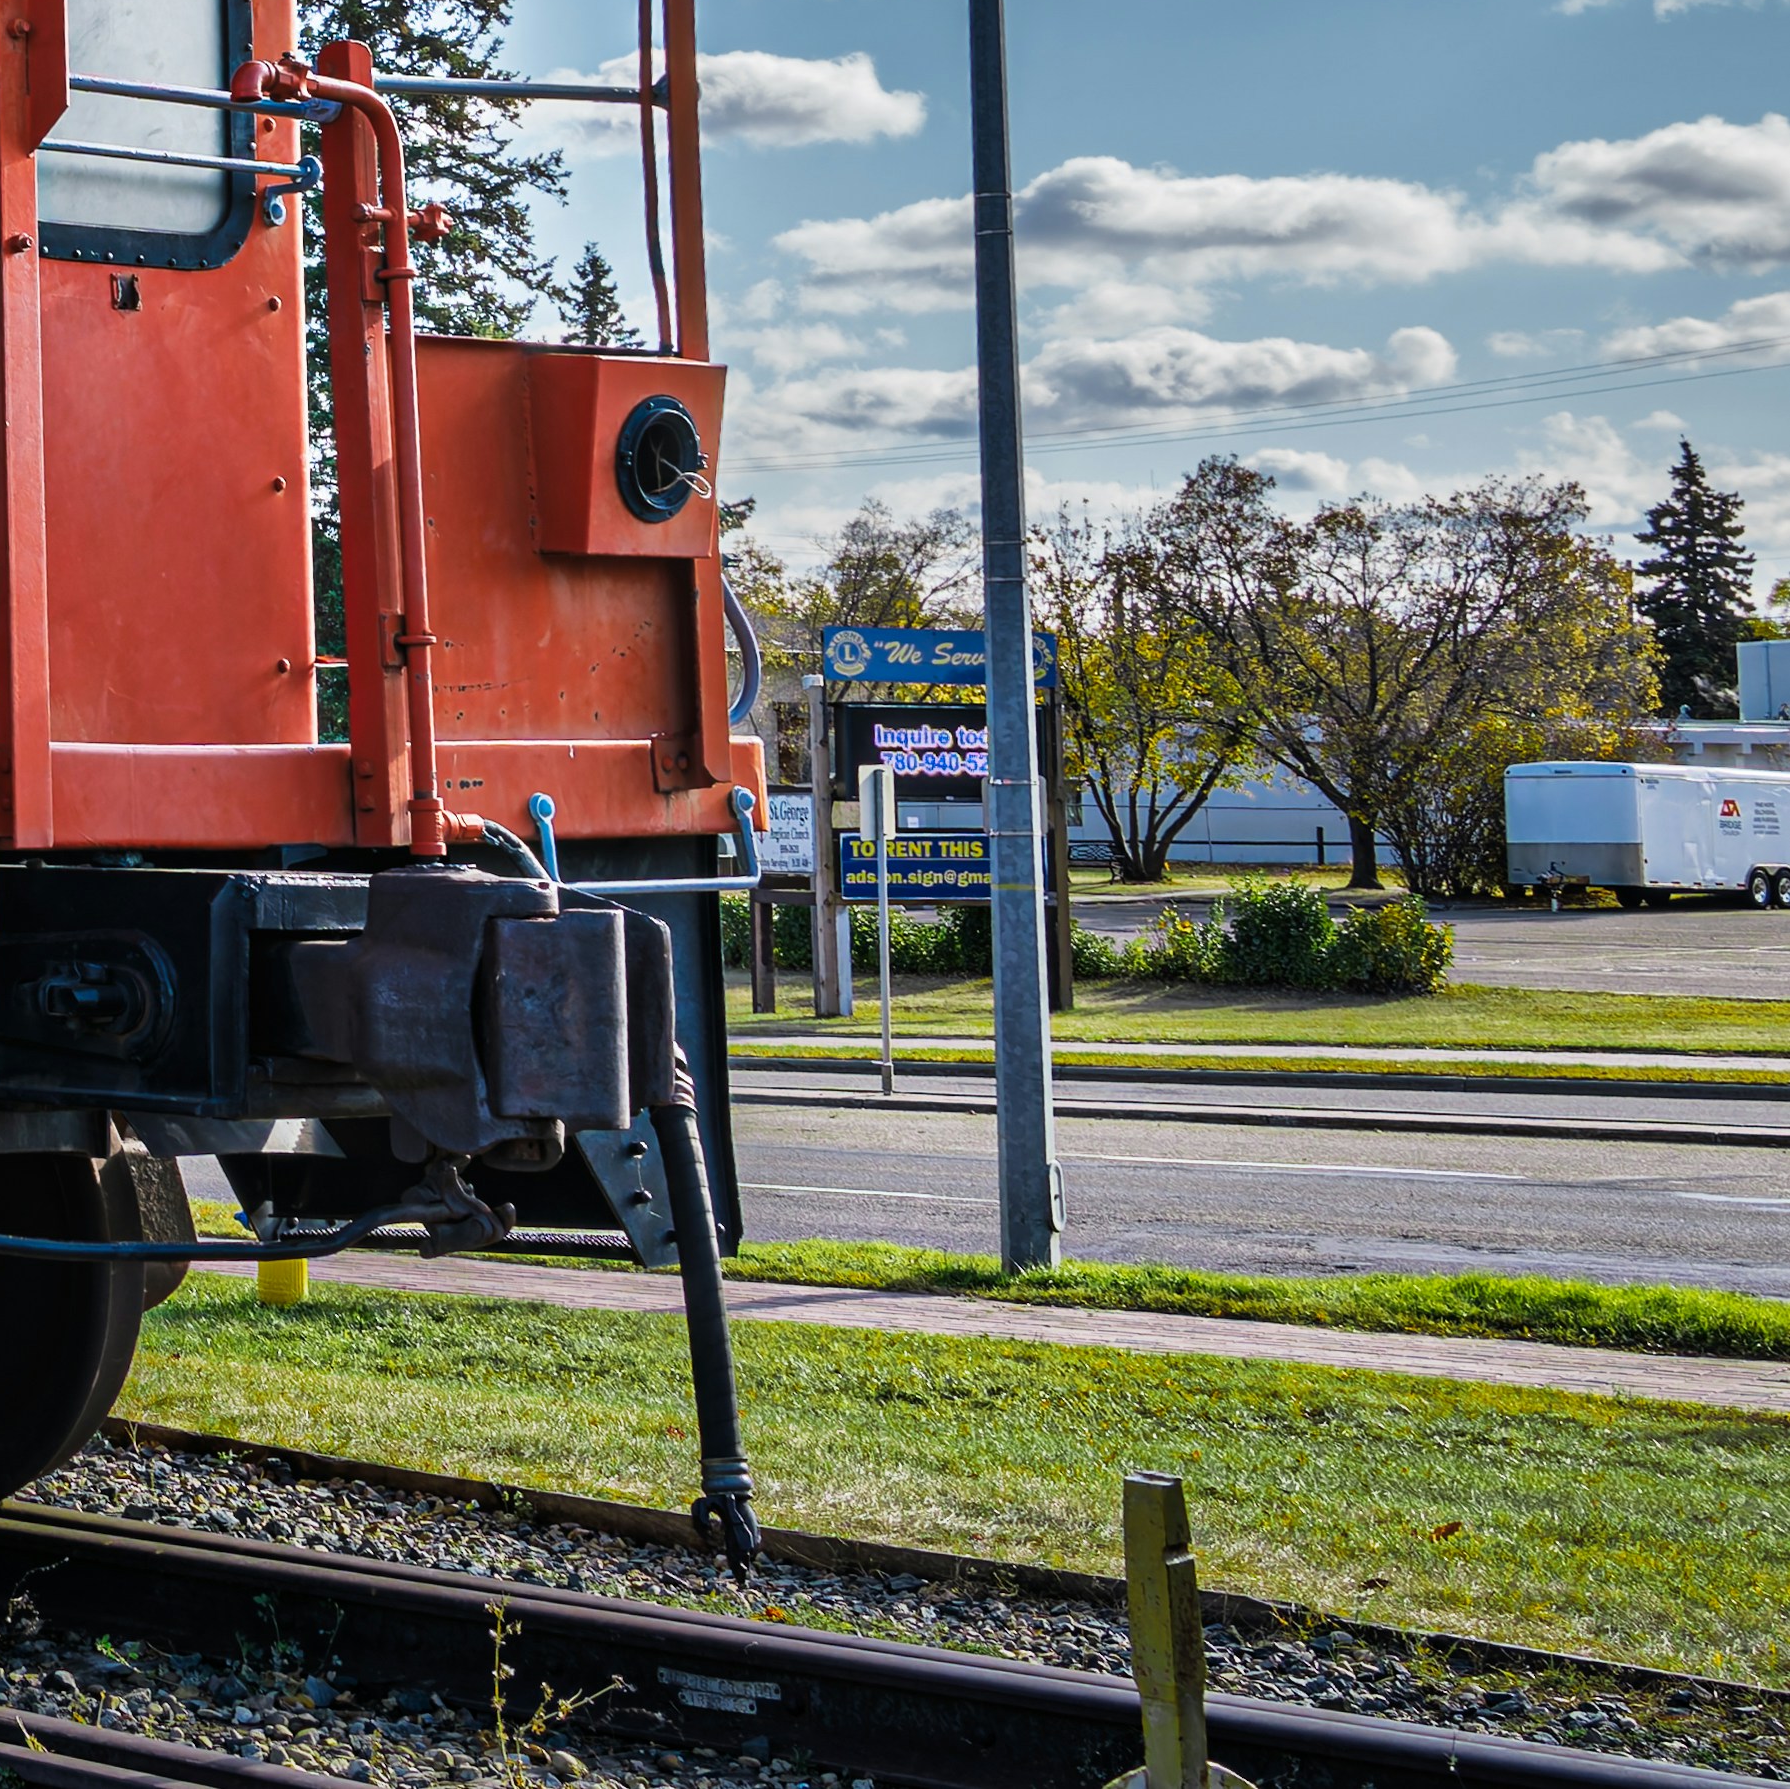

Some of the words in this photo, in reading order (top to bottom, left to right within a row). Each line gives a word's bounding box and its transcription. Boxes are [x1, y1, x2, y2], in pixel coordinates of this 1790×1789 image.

[932, 642, 987, 666] Serv
[875, 724, 953, 750] Inquire
[880, 751, 988, 777] 780-940-52
[850, 841, 876, 858] TO
[885, 841, 933, 858] RENT
[938, 841, 984, 858] THIS
